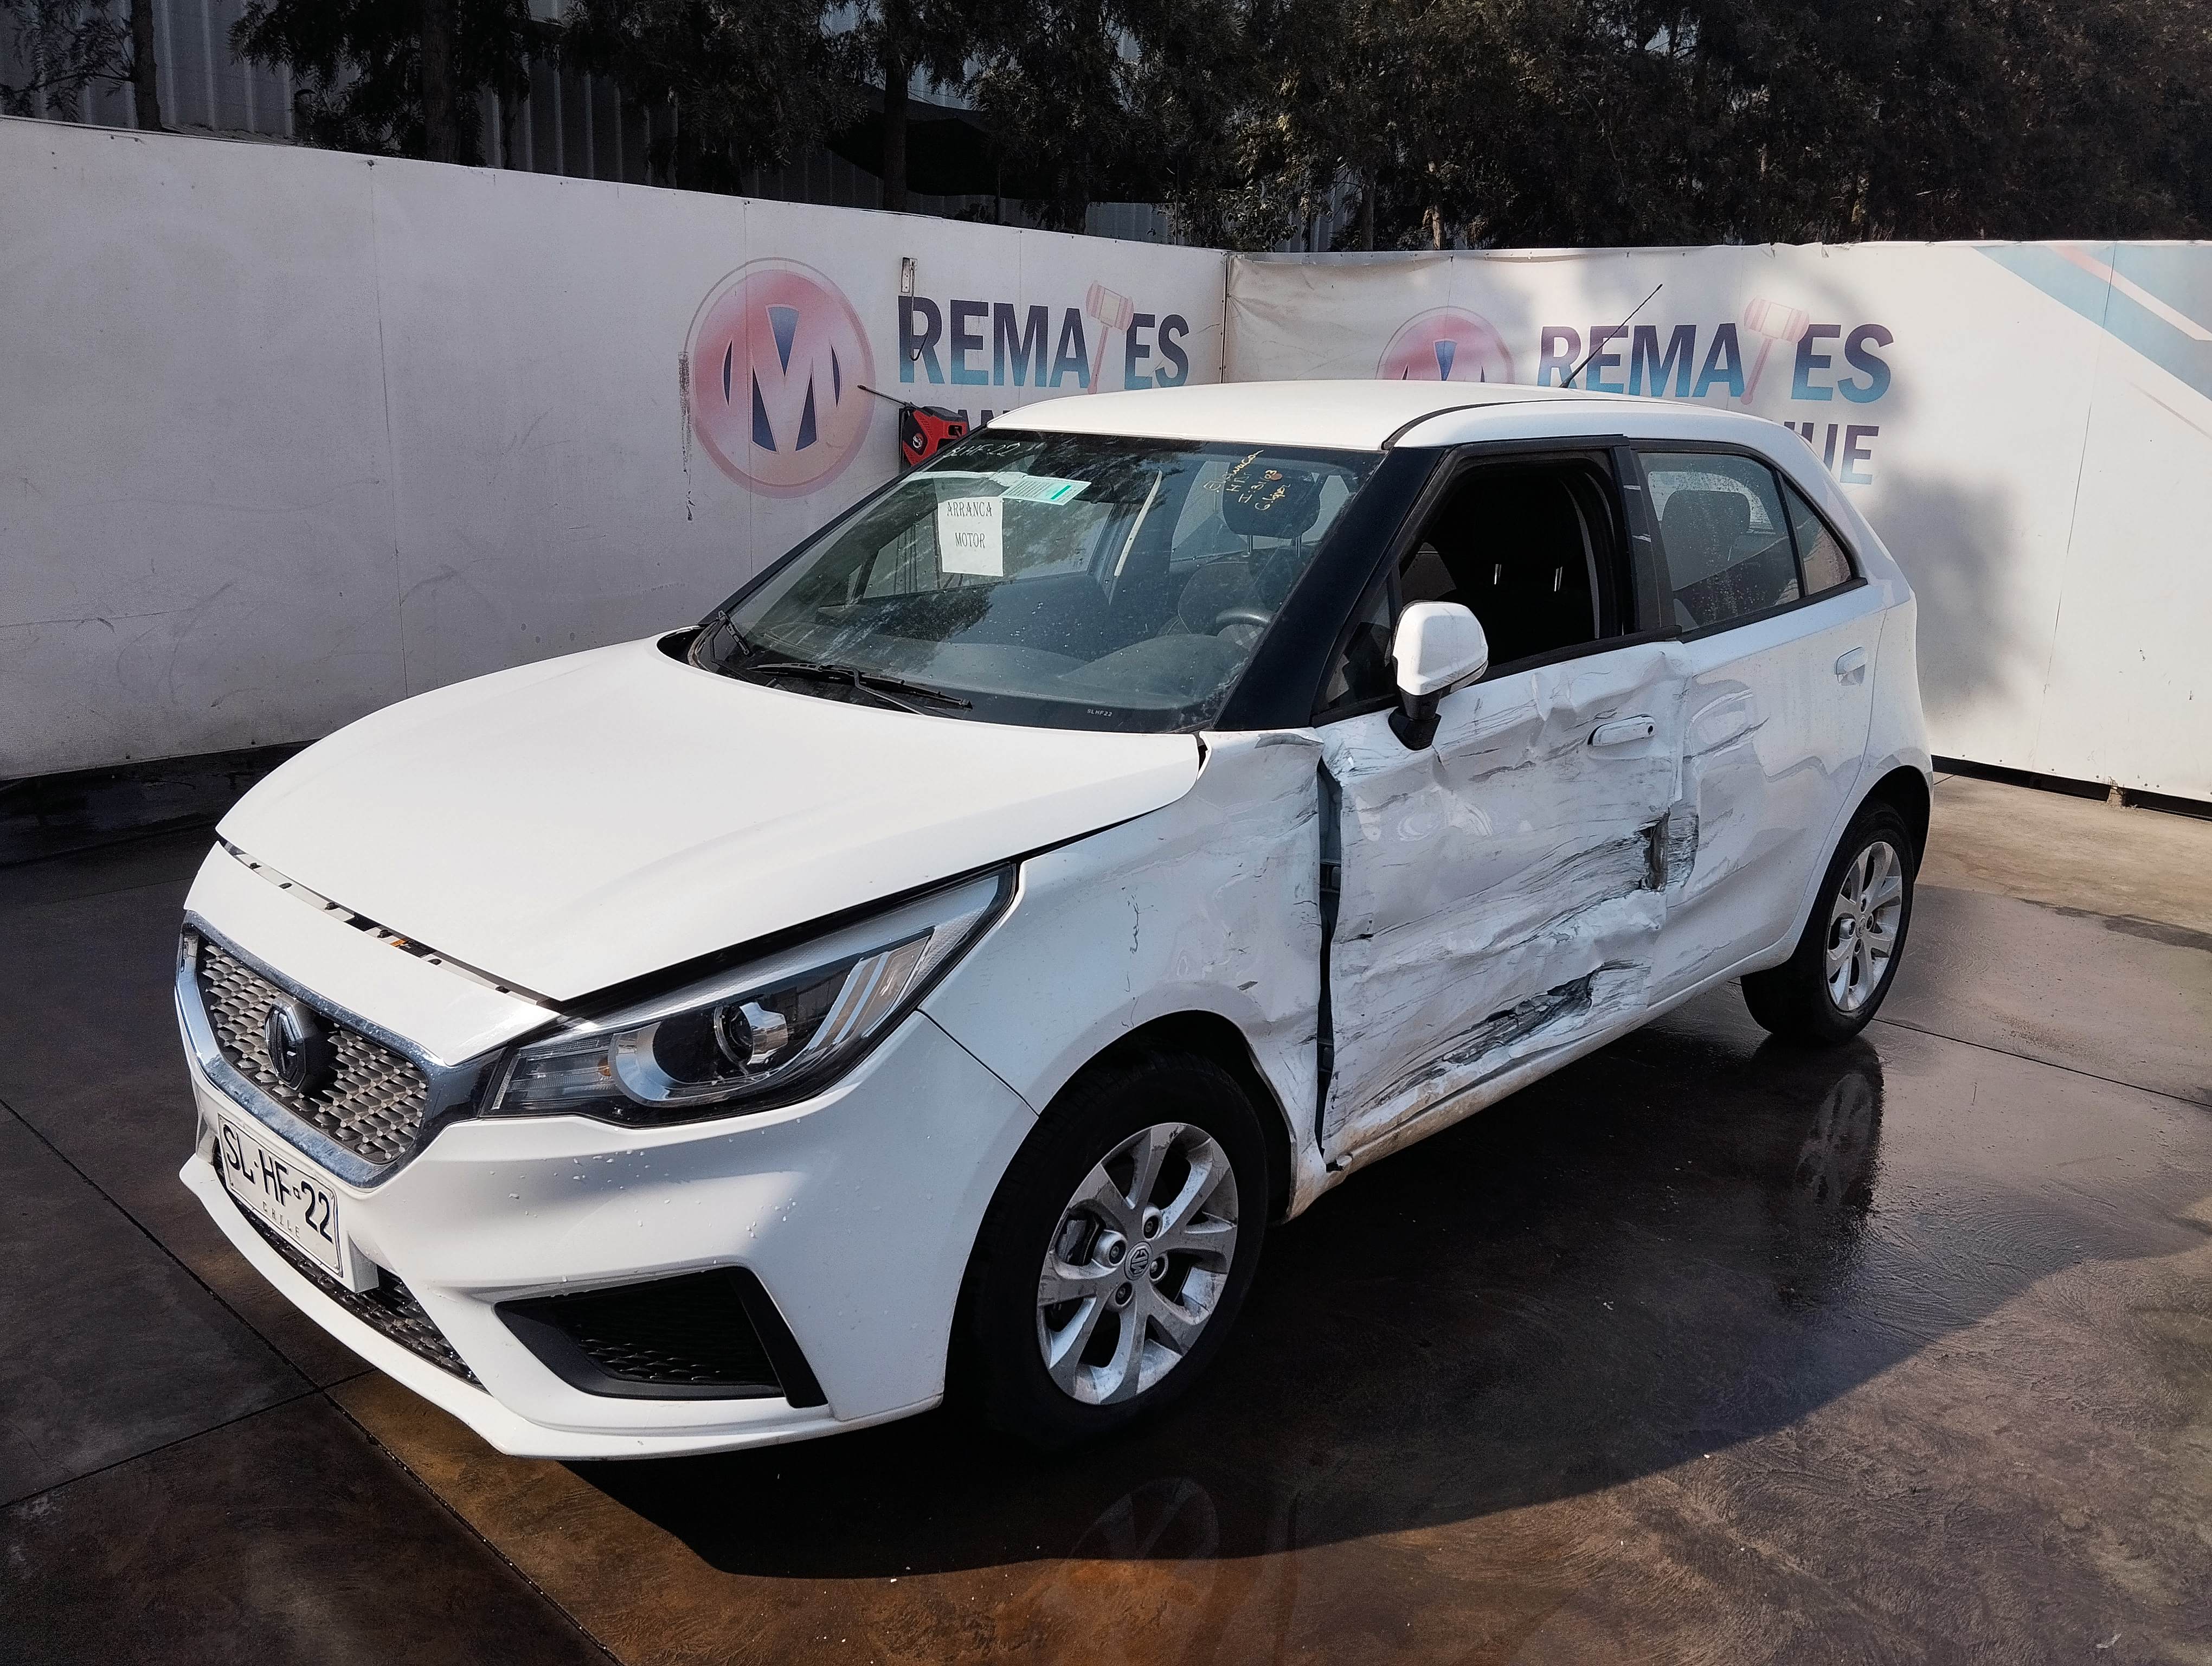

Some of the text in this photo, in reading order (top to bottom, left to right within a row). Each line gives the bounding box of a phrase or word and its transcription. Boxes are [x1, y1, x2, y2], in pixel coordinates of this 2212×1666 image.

[947, 502, 993, 517] ARRANCA
[955, 532, 986, 549] MOTOR
[1086, 708, 1113, 717] SLHF22
[262, 1201, 300, 1239] CHILE
